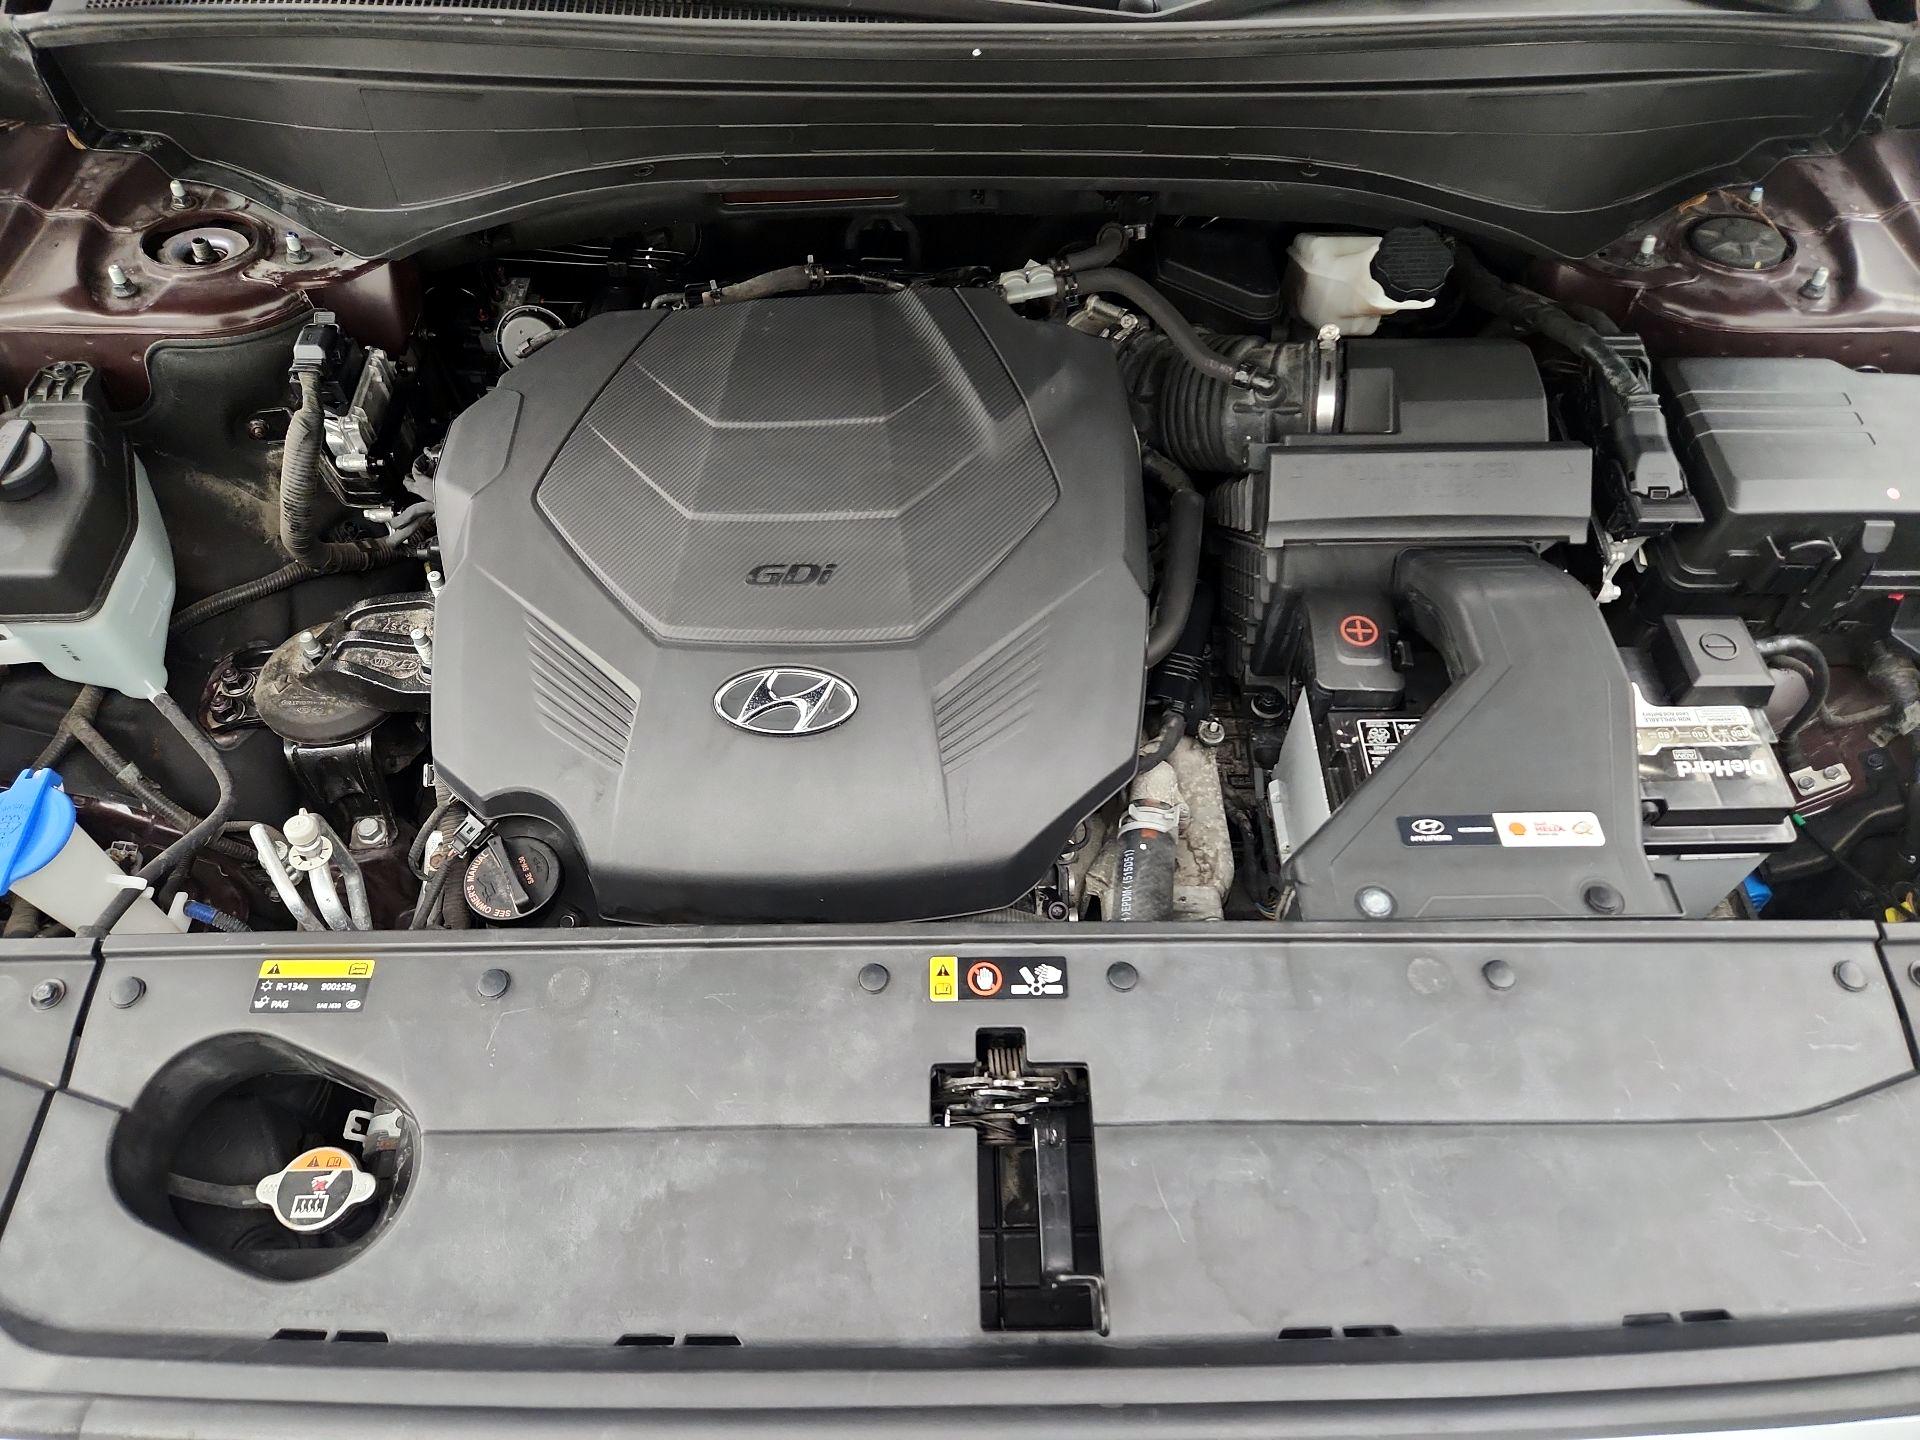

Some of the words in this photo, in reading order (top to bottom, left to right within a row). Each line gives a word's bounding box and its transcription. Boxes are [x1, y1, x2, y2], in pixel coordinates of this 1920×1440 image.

[745, 564, 838, 585] GDi
[1674, 759, 1768, 778] DieHard
[466, 852, 490, 883] MANUAL
[466, 884, 492, 914] OWNER'S
[493, 908, 512, 918] SEE
[275, 982, 308, 991] R-134a
[270, 1000, 289, 1009] PAG
